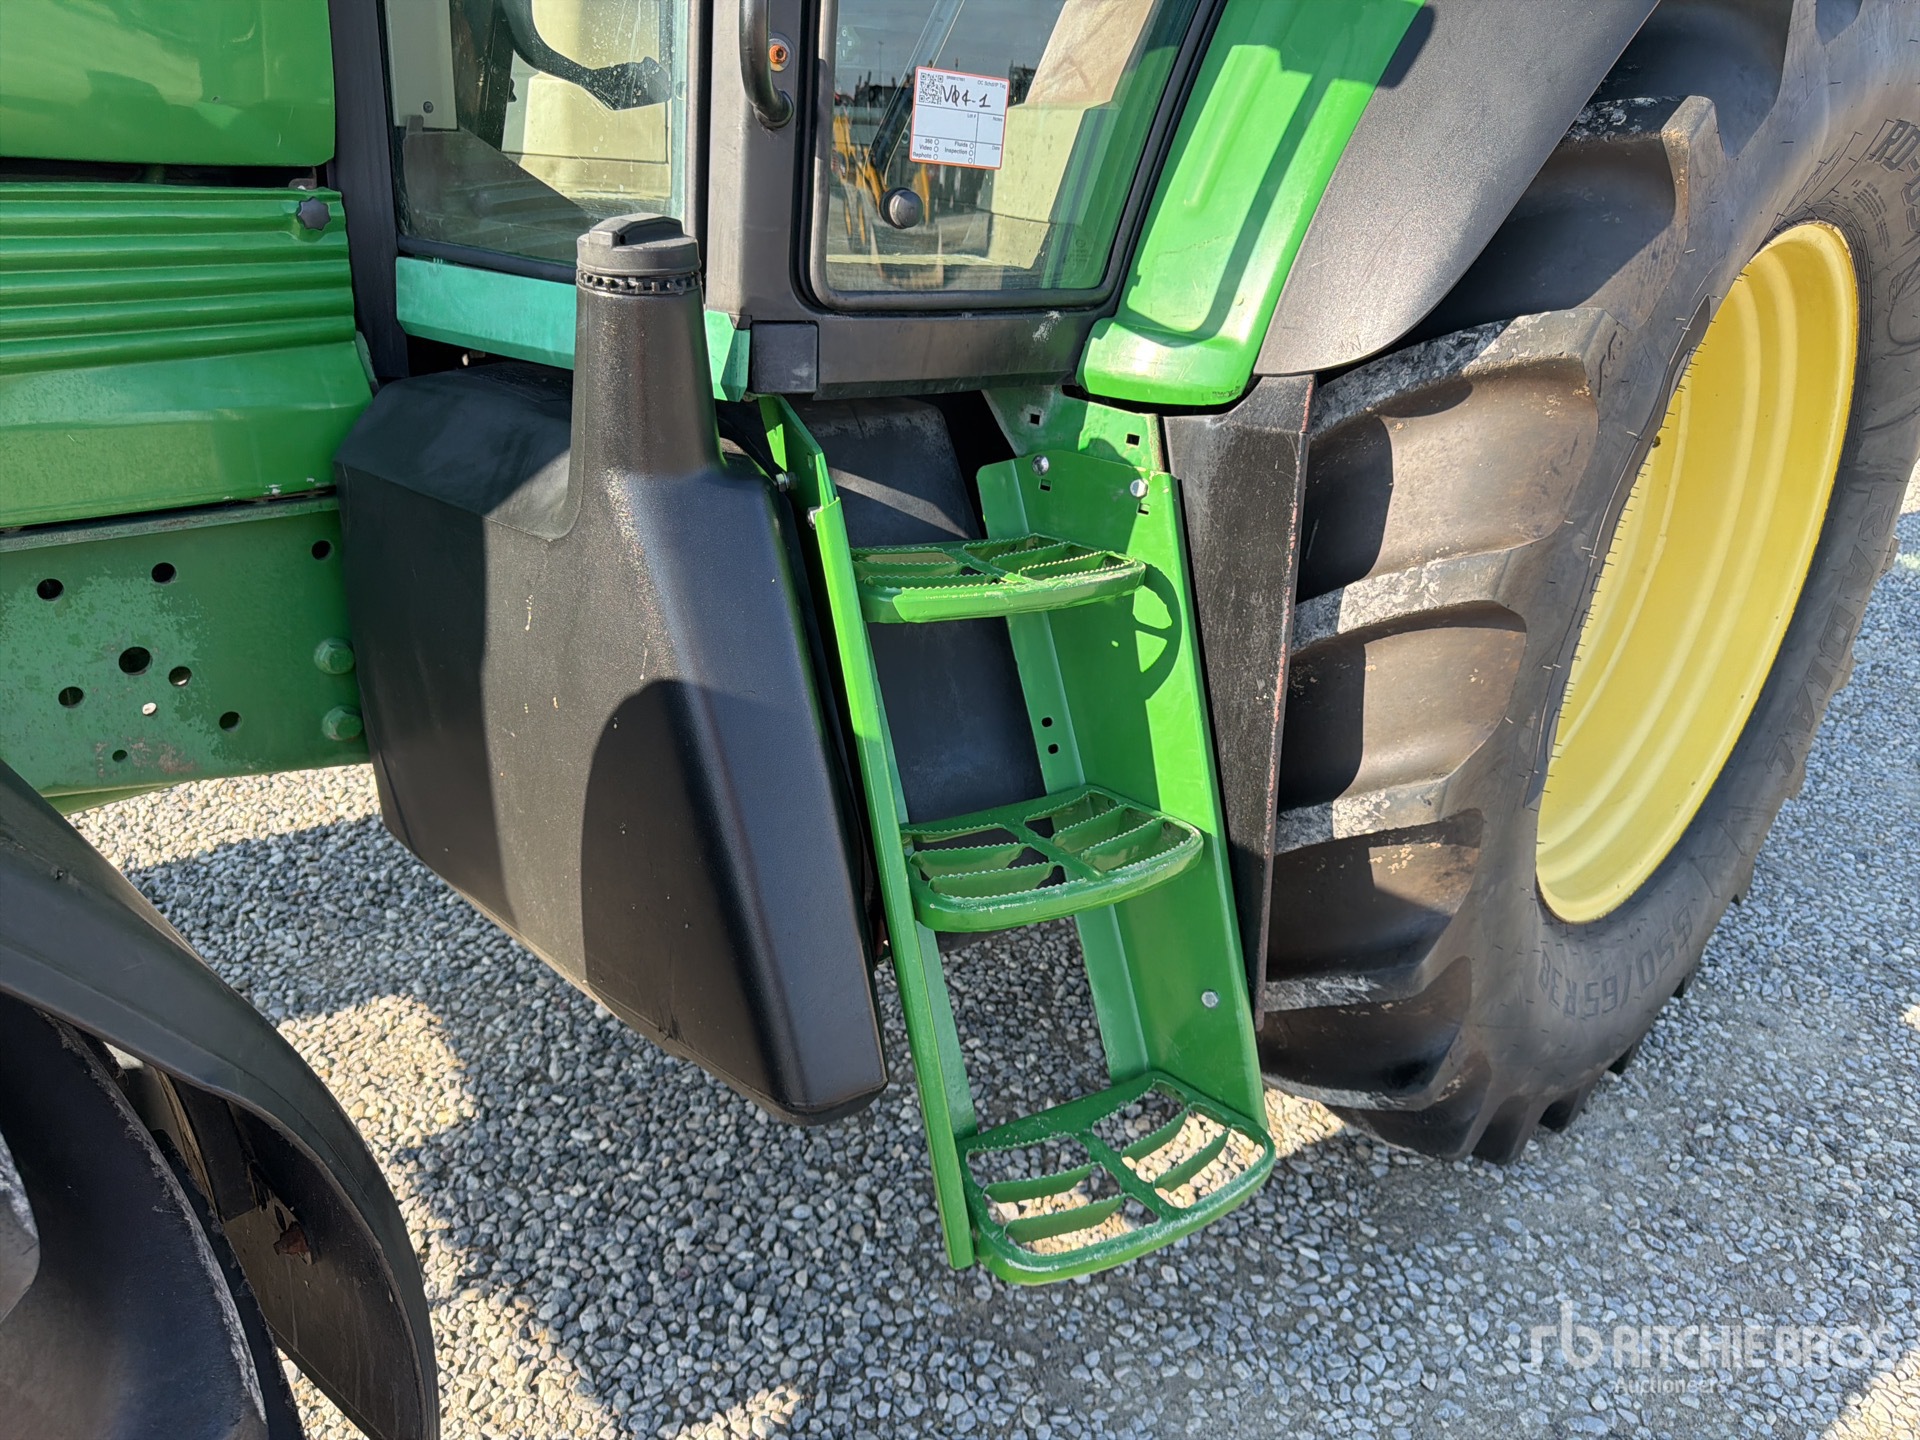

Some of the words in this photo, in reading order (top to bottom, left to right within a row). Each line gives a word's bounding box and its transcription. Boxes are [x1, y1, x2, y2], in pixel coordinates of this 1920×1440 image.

[944, 147, 968, 155] Inspection
[1766, 487, 1900, 777] RADIAL
[1538, 903, 1694, 1020] 650/65R38
